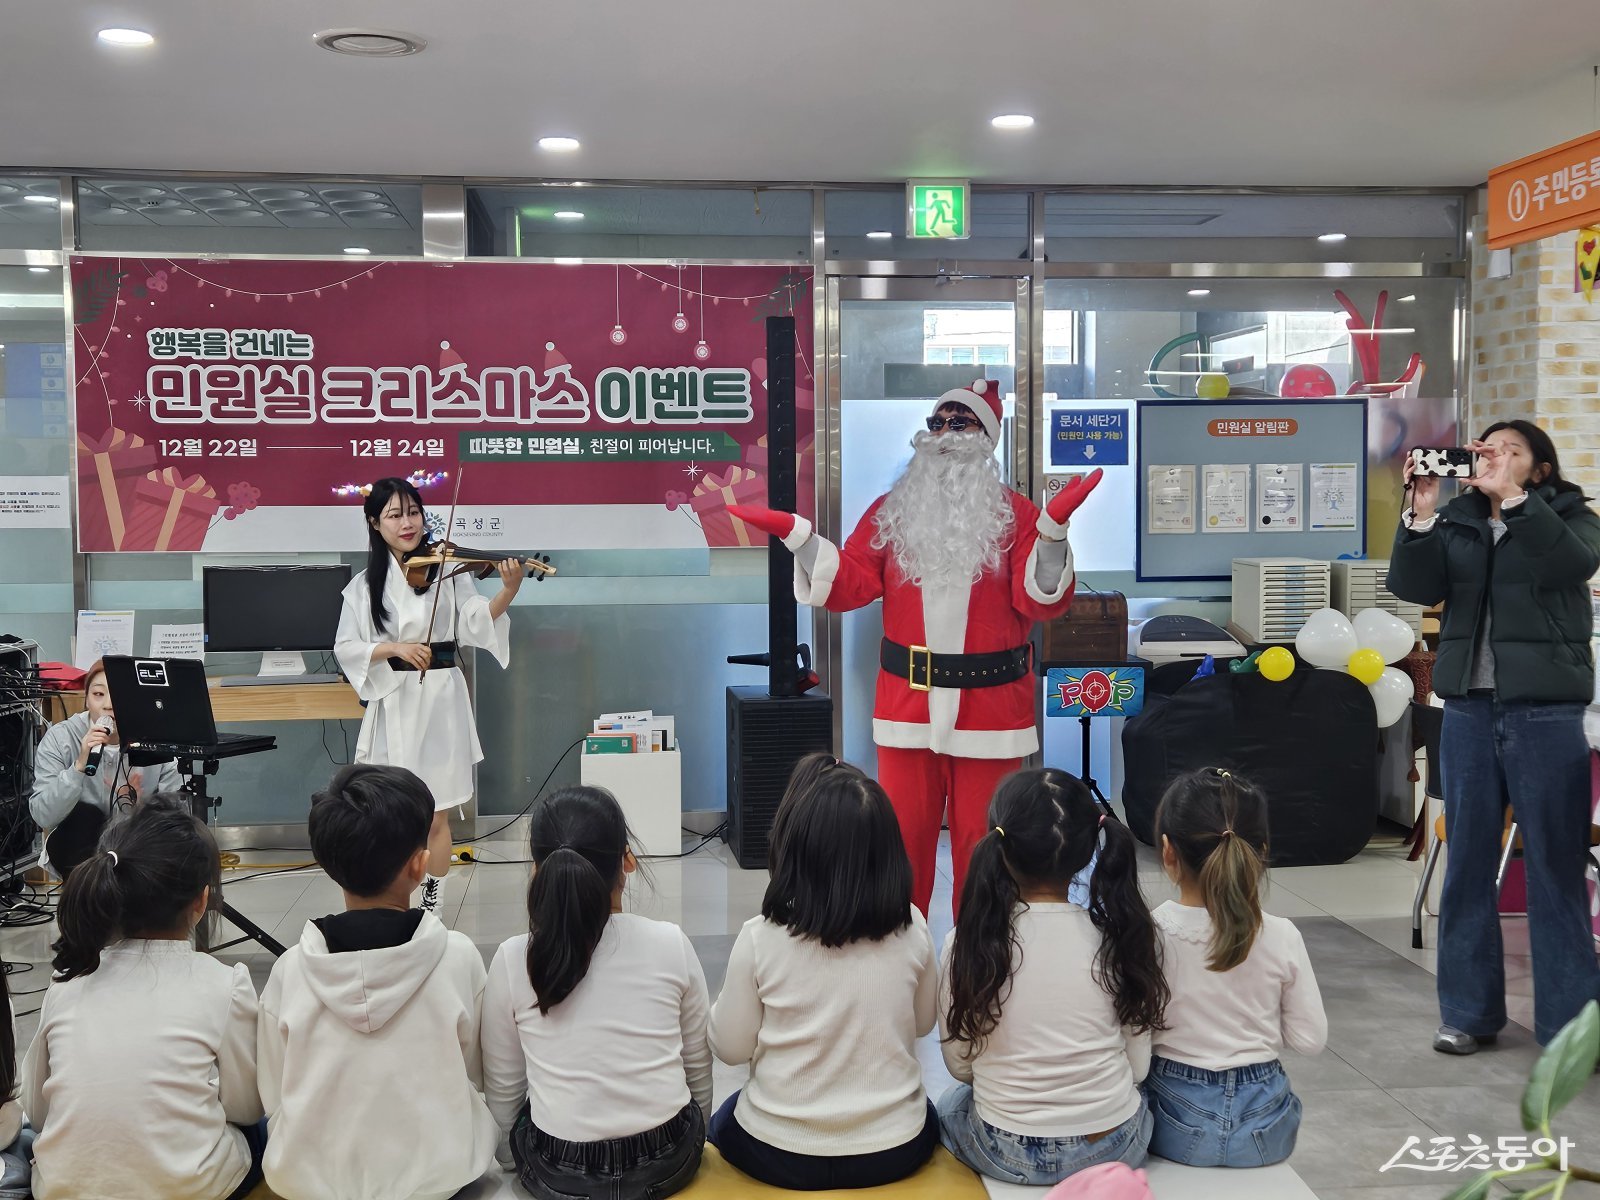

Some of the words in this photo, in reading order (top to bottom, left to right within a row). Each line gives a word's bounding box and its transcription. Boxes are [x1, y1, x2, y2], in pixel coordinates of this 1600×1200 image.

[147, 328, 229, 359] 행복을
[231, 328, 314, 360] 건네는
[147, 364, 317, 424] 민원실
[321, 362, 591, 424] 크리스마스
[595, 366, 754, 424] 이벤트
[1059, 415, 1083, 427] 문서
[1086, 415, 1121, 427] 세단기
[1217, 421, 1251, 434] 민원실
[1254, 421, 1290, 434] 알림판
[1057, 431, 1084, 441] (민원인
[1086, 431, 1102, 440] 사용
[1104, 431, 1123, 440] 가능)
[159, 438, 203, 457] 12월
[208, 438, 258, 457] 22일
[350, 438, 392, 457] 12월
[397, 438, 445, 457] 24일
[469, 437, 523, 455] 따뜻한
[527, 437, 585, 456] 민원실,
[589, 438, 634, 455] 친절이
[638, 438, 716, 455] 피어납니다.
[1058, 671, 1135, 713] POP
